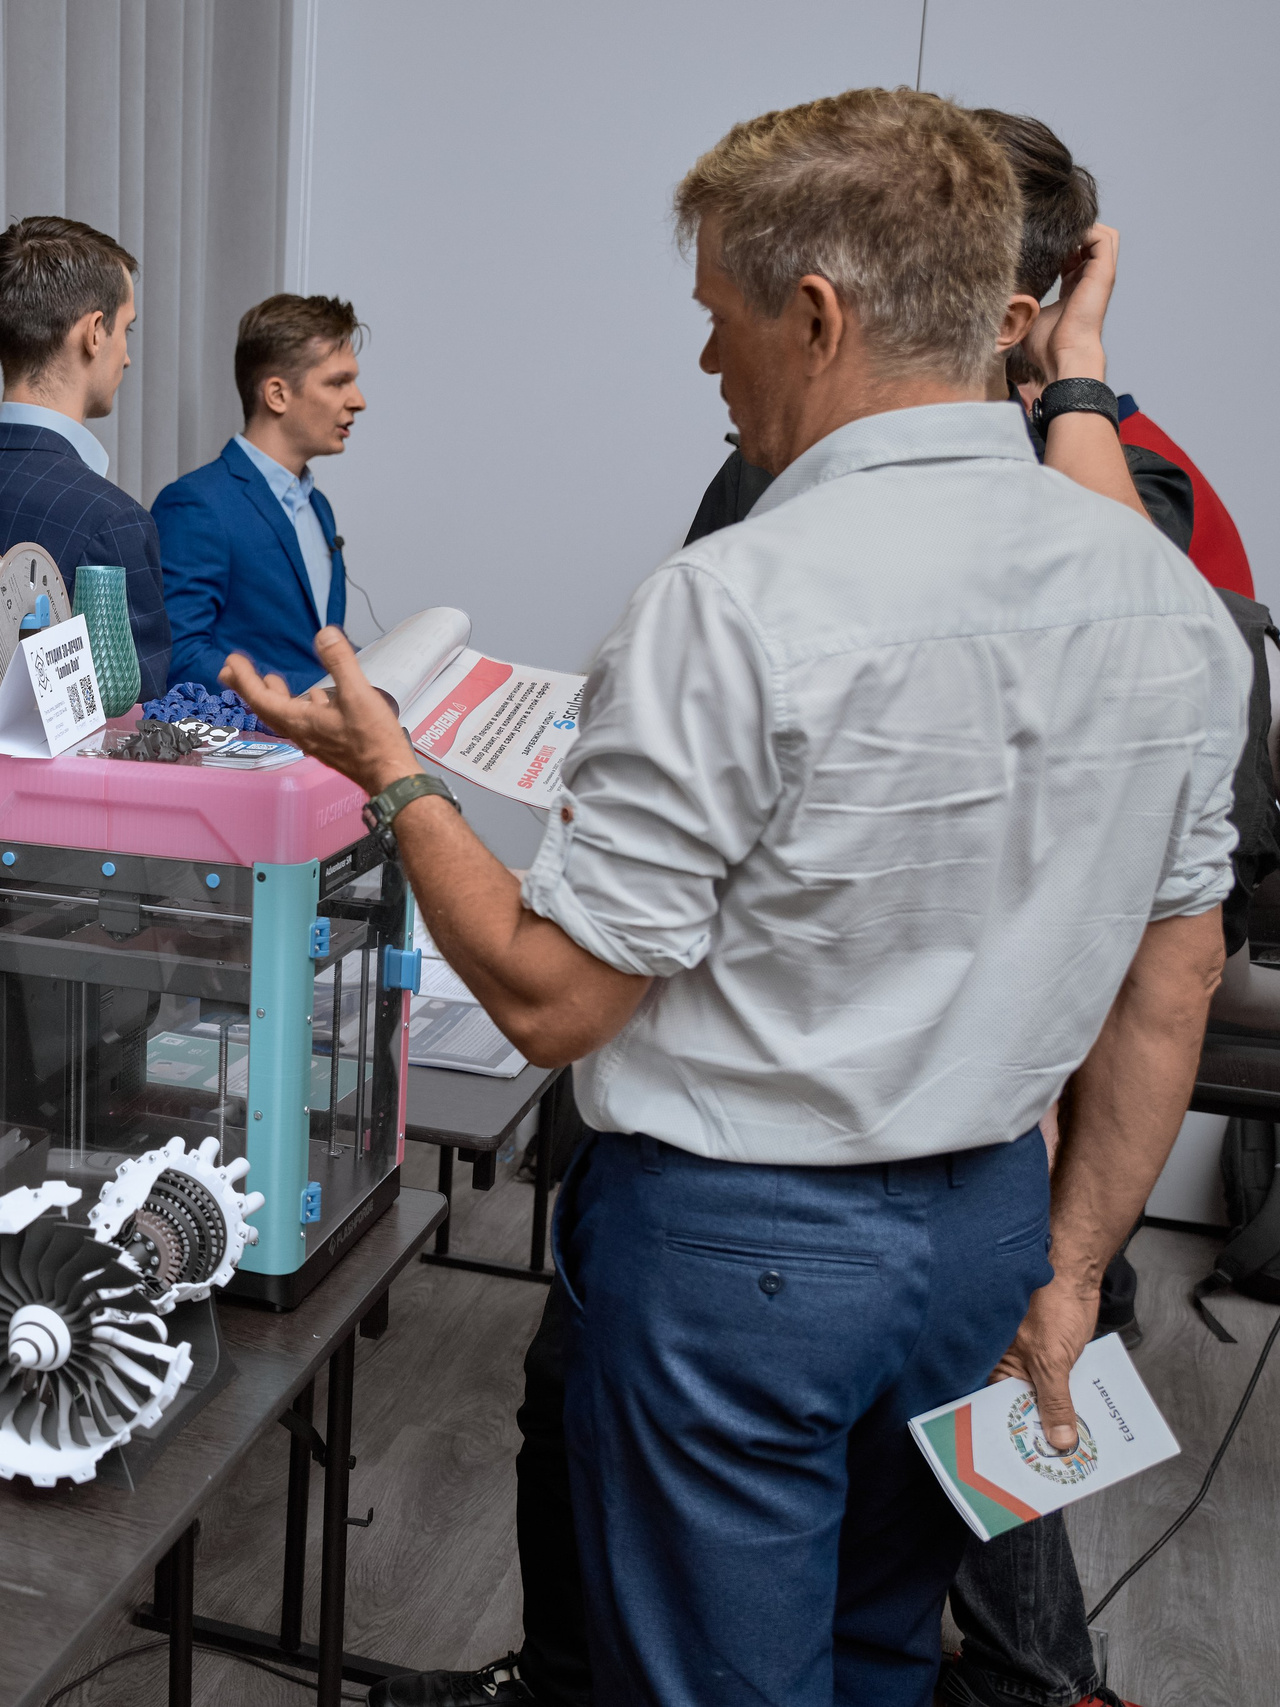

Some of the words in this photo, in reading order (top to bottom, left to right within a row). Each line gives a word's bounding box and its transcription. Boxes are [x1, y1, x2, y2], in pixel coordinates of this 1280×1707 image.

[45, 646, 63, 666] СТУДИЯ
[416, 708, 462, 750] ПРОБЛЕМА
[460, 741, 477, 757] Рынок
[479, 721, 494, 737] печати
[494, 701, 510, 718] нашем
[506, 681, 524, 702] регионе
[472, 751, 485, 764] мало
[482, 736, 500, 754] развит,
[495, 726, 505, 736] нет
[502, 702, 523, 727] компаний
[520, 682, 538, 703] которые
[482, 744, 506, 773] предлагают
[503, 732, 516, 744] свои
[512, 714, 528, 733] услуги
[528, 699, 539, 711] этой
[535, 682, 551, 698] сфере
[521, 725, 547, 756] ЗАРУБЕЖНЫЙ
[542, 710, 557, 725] ОПЫТ:
[1091, 1378, 1135, 1442] EduSmart
